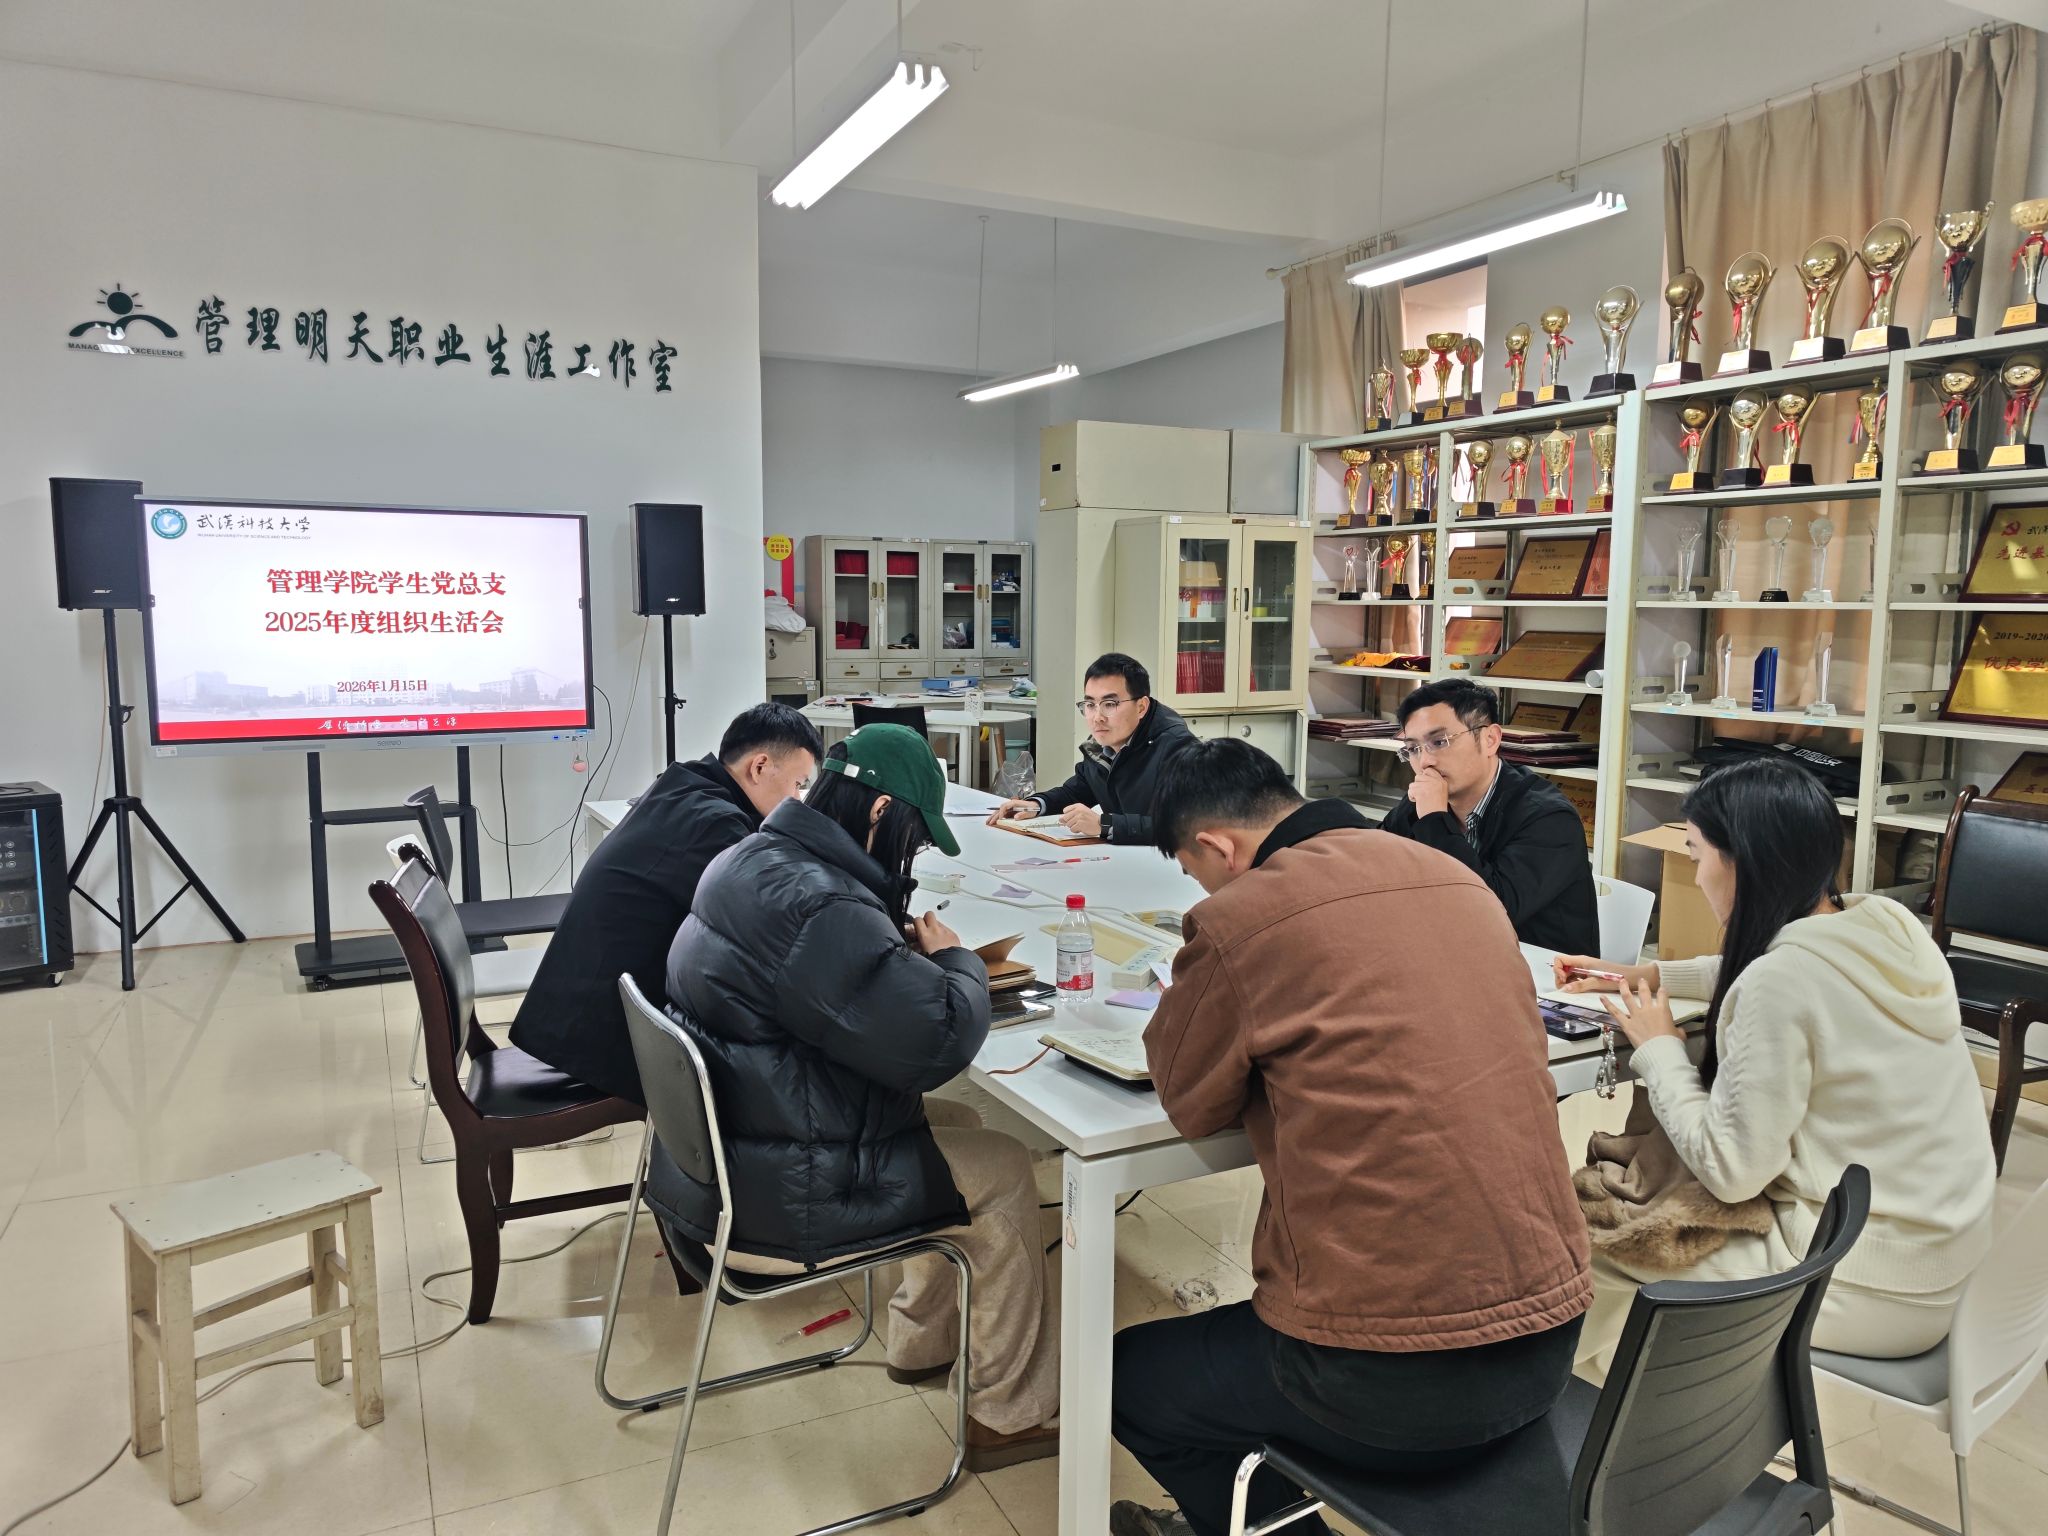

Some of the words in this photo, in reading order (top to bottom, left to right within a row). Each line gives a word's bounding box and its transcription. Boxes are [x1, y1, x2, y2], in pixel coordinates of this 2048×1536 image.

[195, 295, 679, 393] 管理明天职业生涯工作室
[266, 569, 506, 596] 管理学院学生党总支
[265, 610, 504, 635] 2025年度组织生活会
[337, 679, 428, 693] 2026年1月15日
